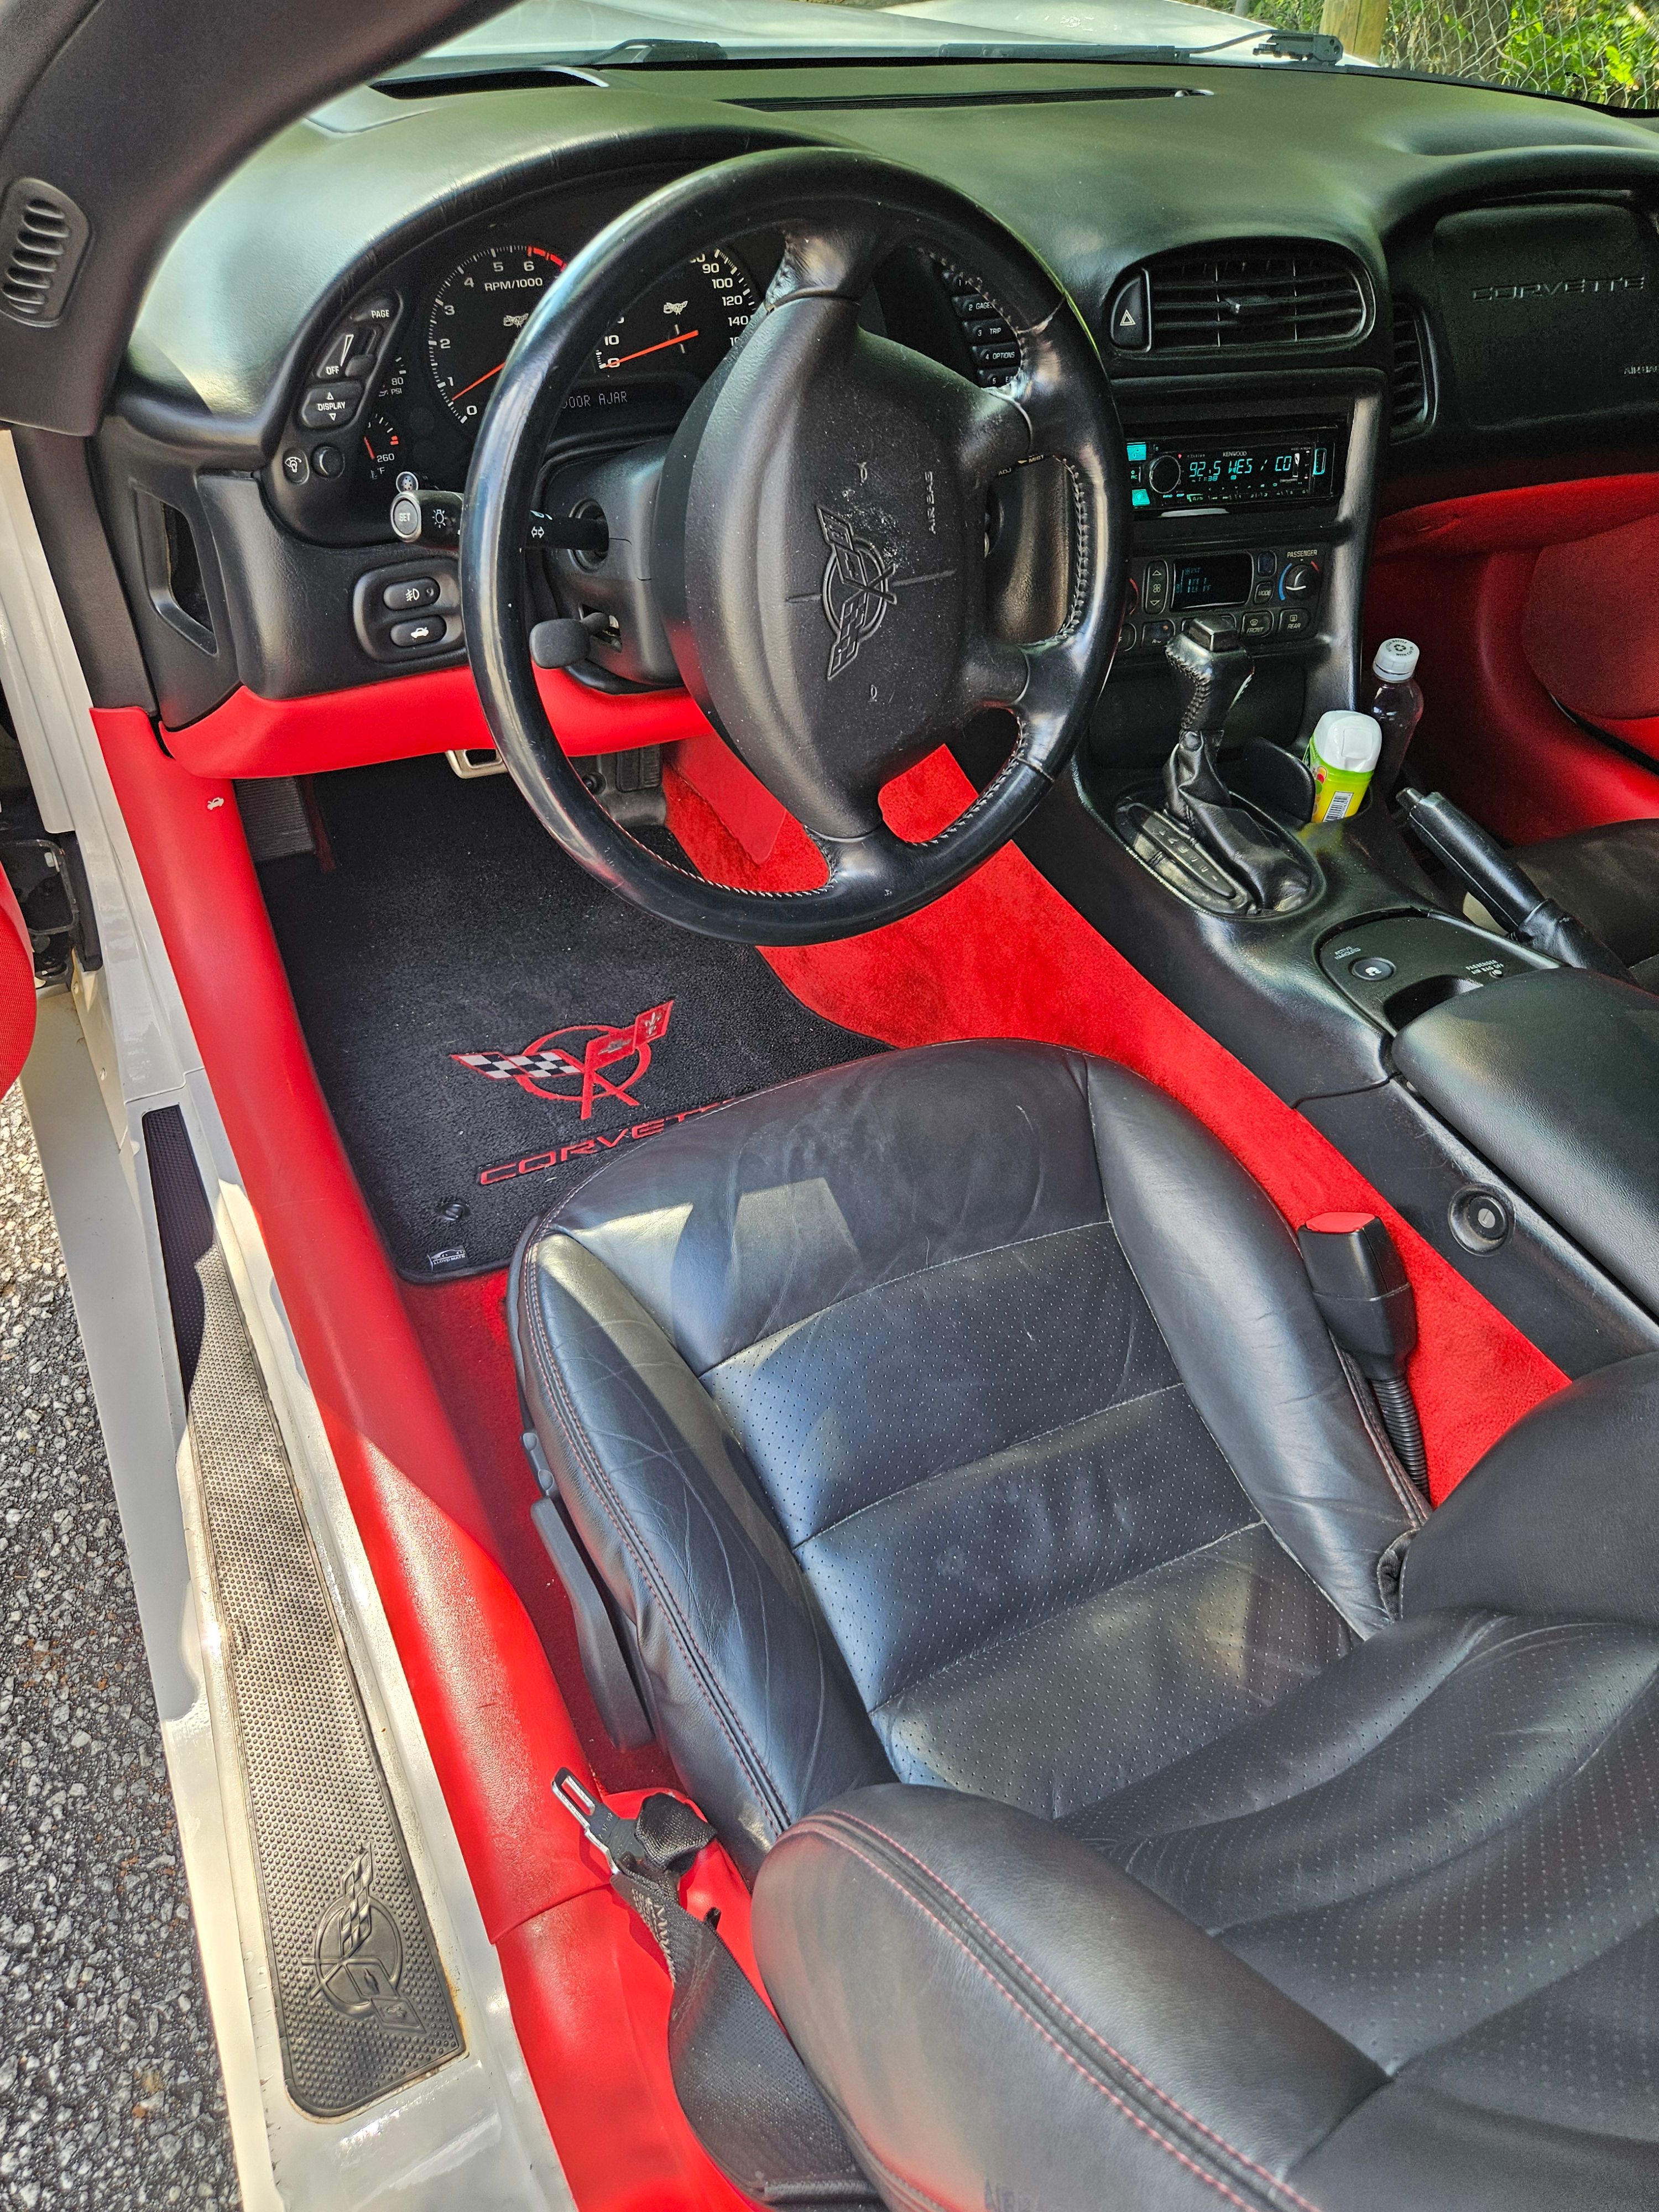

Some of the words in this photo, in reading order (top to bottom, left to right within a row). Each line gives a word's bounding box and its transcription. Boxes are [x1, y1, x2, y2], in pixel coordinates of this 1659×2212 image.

[493, 262, 504, 272] 5
[524, 261, 535, 272] 6
[702, 263, 720, 274] 90
[464, 278, 475, 288] 4
[484, 278, 543, 292] RPM/1000
[712, 278, 733, 289] 100
[1472, 276, 1645, 300] CORVETTE
[722, 295, 743, 306] 120
[371, 310, 390, 319] PAGE
[445, 305, 456, 316] 3
[728, 315, 749, 327] 140
[989, 327, 1001, 335] TRIP
[440, 338, 451, 349] 2
[604, 335, 620, 346] 10
[992, 351, 1015, 360] OPTIONS
[607, 357, 620, 368] 0
[325, 366, 339, 375] OFF
[391, 377, 404, 385] 80
[447, 377, 454, 387] 1
[599, 391, 628, 405] AJAR
[317, 401, 346, 411] DISPLAY
[466, 405, 478, 415] 0
[377, 453, 394, 463] 260
[398, 513, 411, 522] SET
[1287, 549, 1318, 559] PASSENGER
[1246, 626, 1264, 634] FRONT
[1465, 959, 1498, 971] PASSENGER
